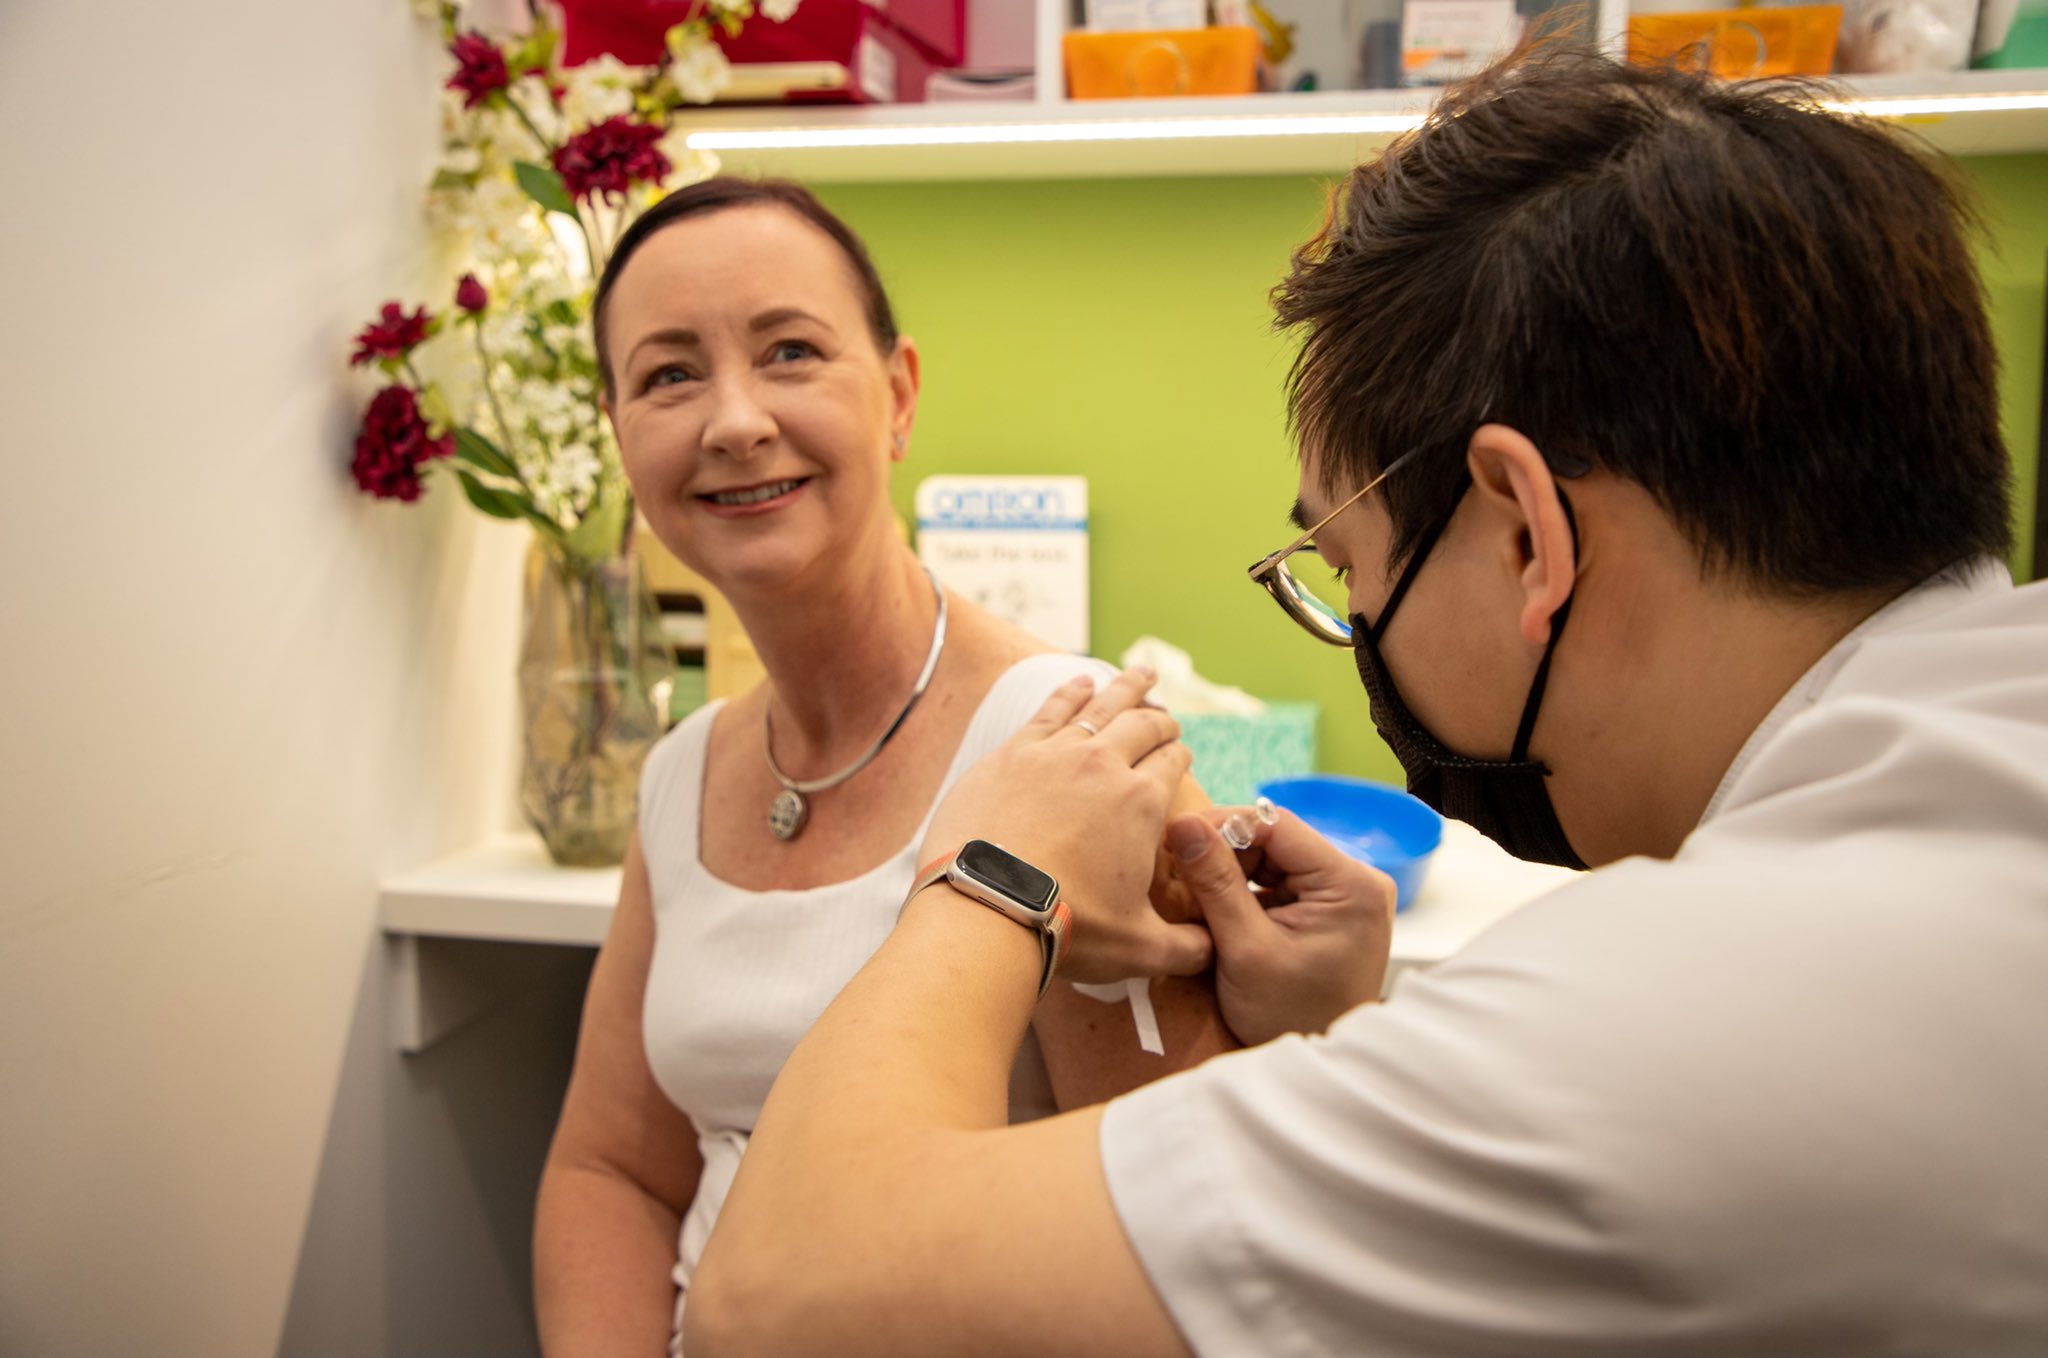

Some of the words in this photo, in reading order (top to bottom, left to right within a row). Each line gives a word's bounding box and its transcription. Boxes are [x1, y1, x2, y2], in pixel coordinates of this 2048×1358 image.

[932, 486, 1065, 520] OMRON
[937, 541, 981, 561] Take
[987, 542, 1020, 561] the
